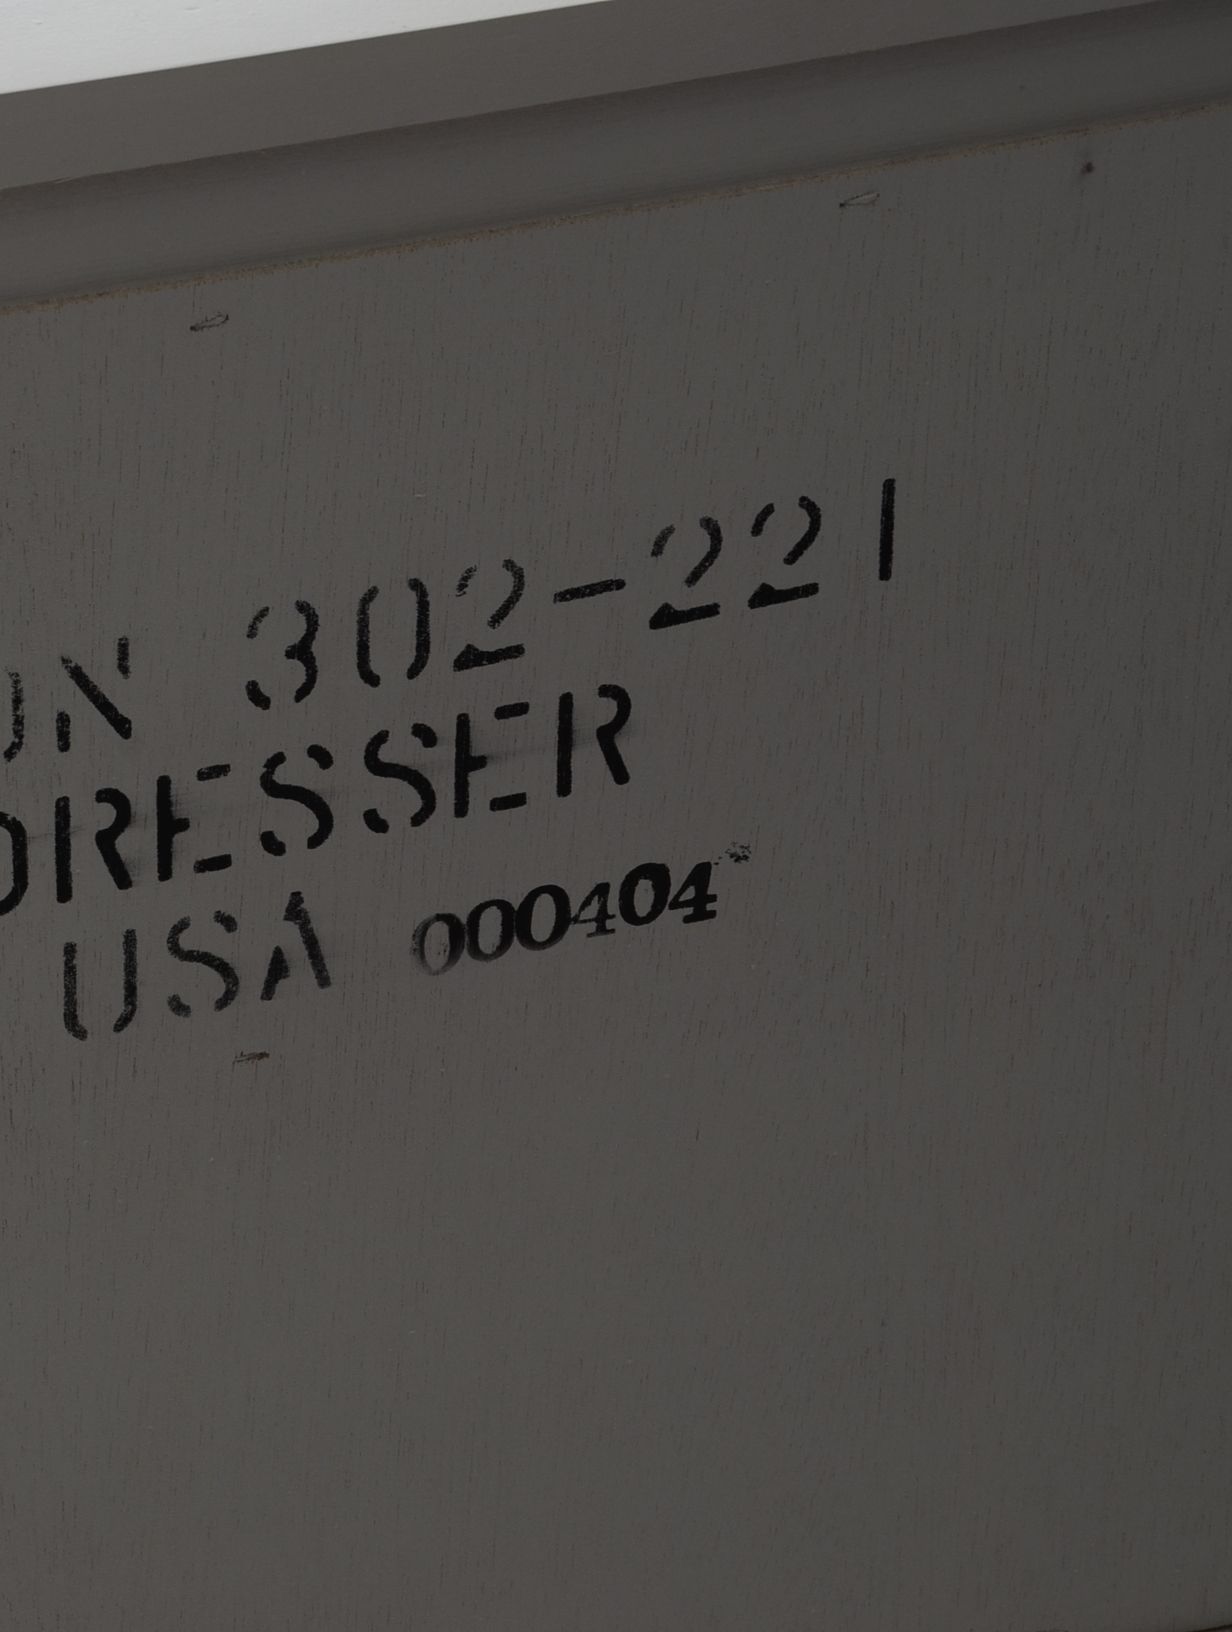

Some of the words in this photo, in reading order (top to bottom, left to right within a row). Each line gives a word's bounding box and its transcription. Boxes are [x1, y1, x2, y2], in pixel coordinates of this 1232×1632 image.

[243, 477, 898, 712] 302-221
[61, 890, 333, 1042] USA
[411, 860, 718, 976] 000404
